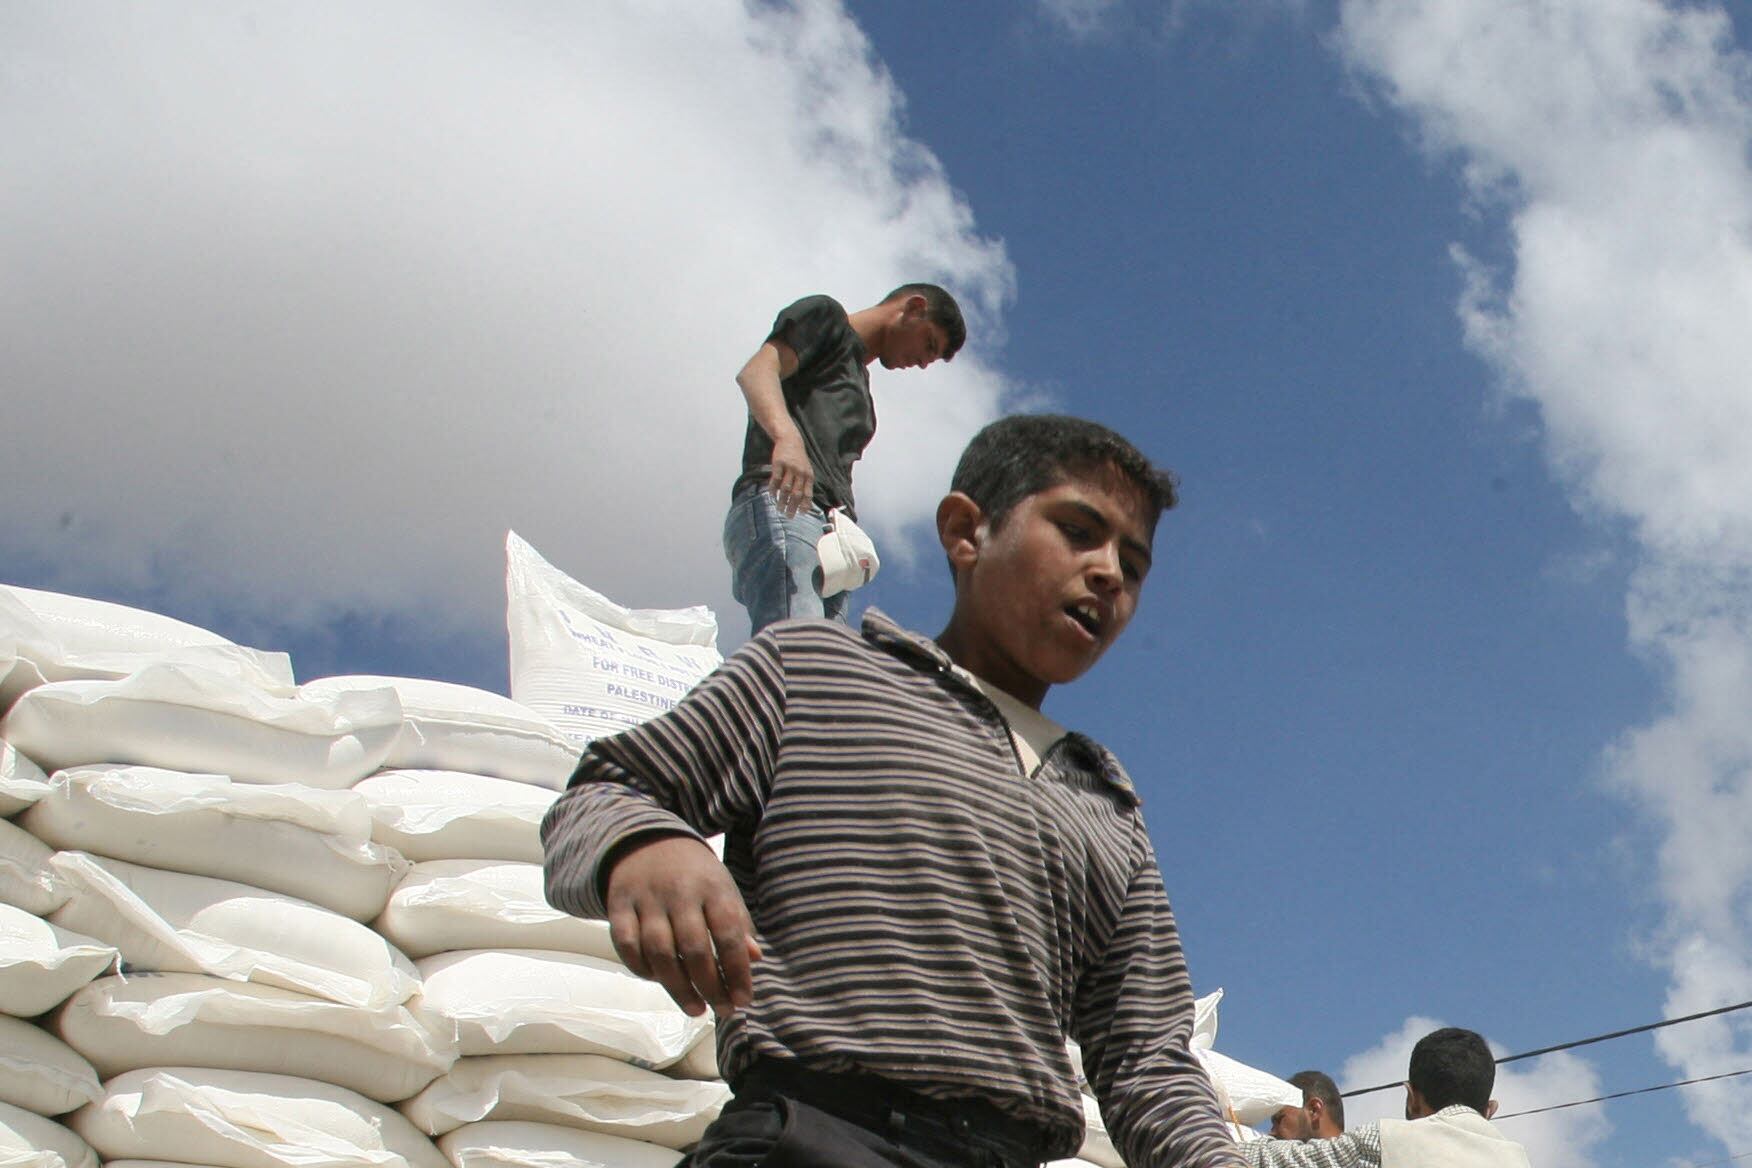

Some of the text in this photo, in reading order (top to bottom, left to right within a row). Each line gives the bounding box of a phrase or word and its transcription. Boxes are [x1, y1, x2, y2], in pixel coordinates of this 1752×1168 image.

[593, 656, 619, 674] FOR
[623, 664, 655, 683] FREE
[607, 683, 677, 710] PALESTINE
